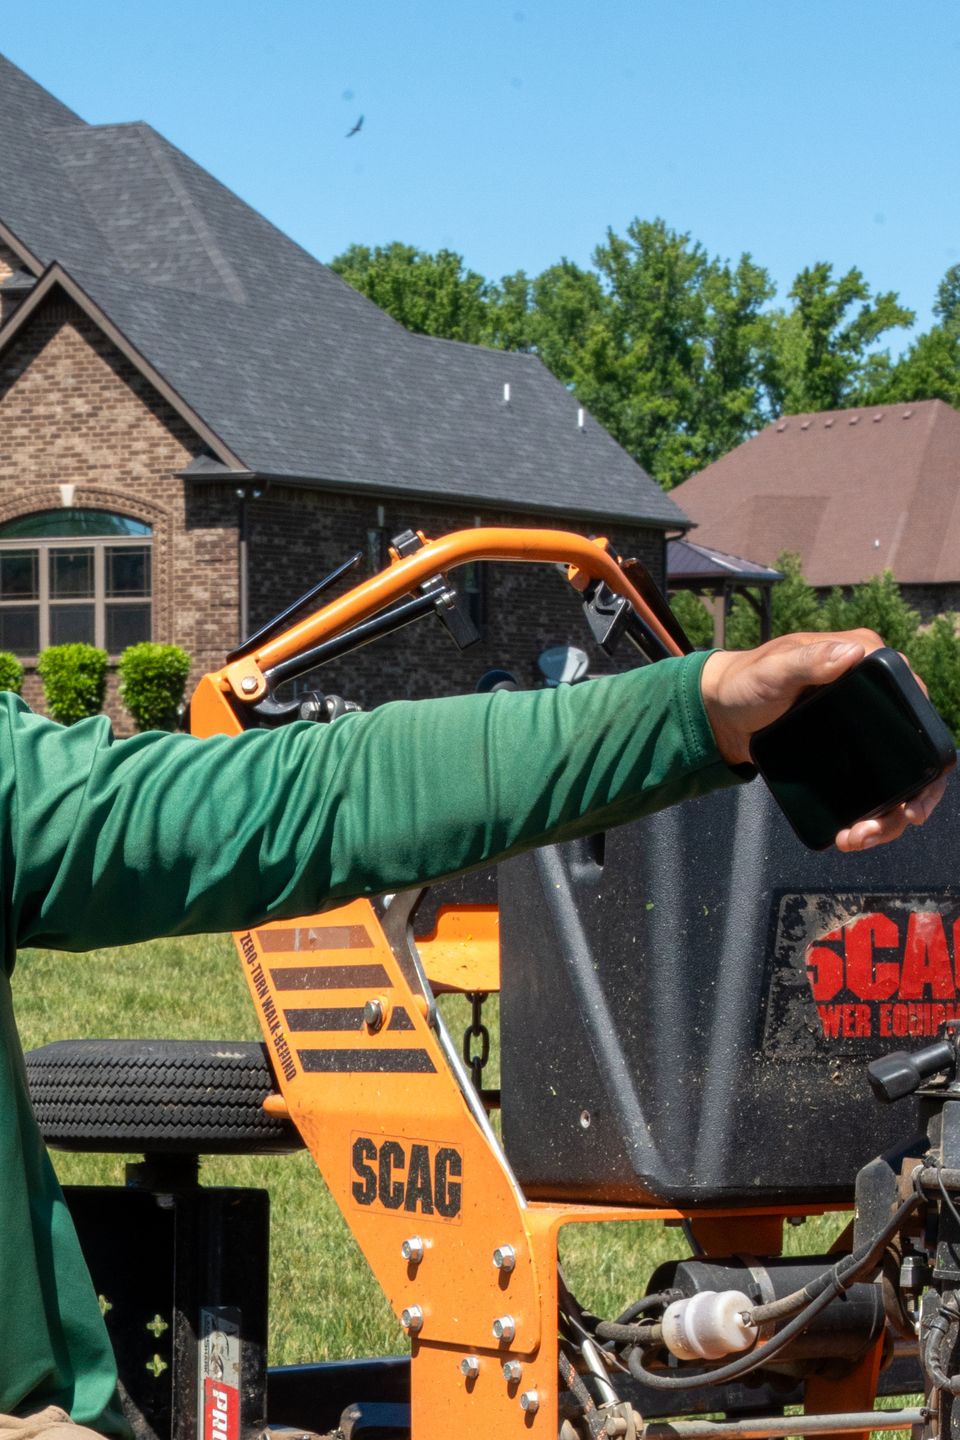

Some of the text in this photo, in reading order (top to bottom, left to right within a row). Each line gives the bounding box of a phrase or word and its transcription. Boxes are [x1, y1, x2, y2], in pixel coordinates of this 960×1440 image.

[806, 912, 960, 1000] SCA
[240, 932, 297, 1082] ZERO-TURN WALK-BEHIND
[817, 1004, 871, 1037] WER
[351, 1136, 462, 1218] SCAG
